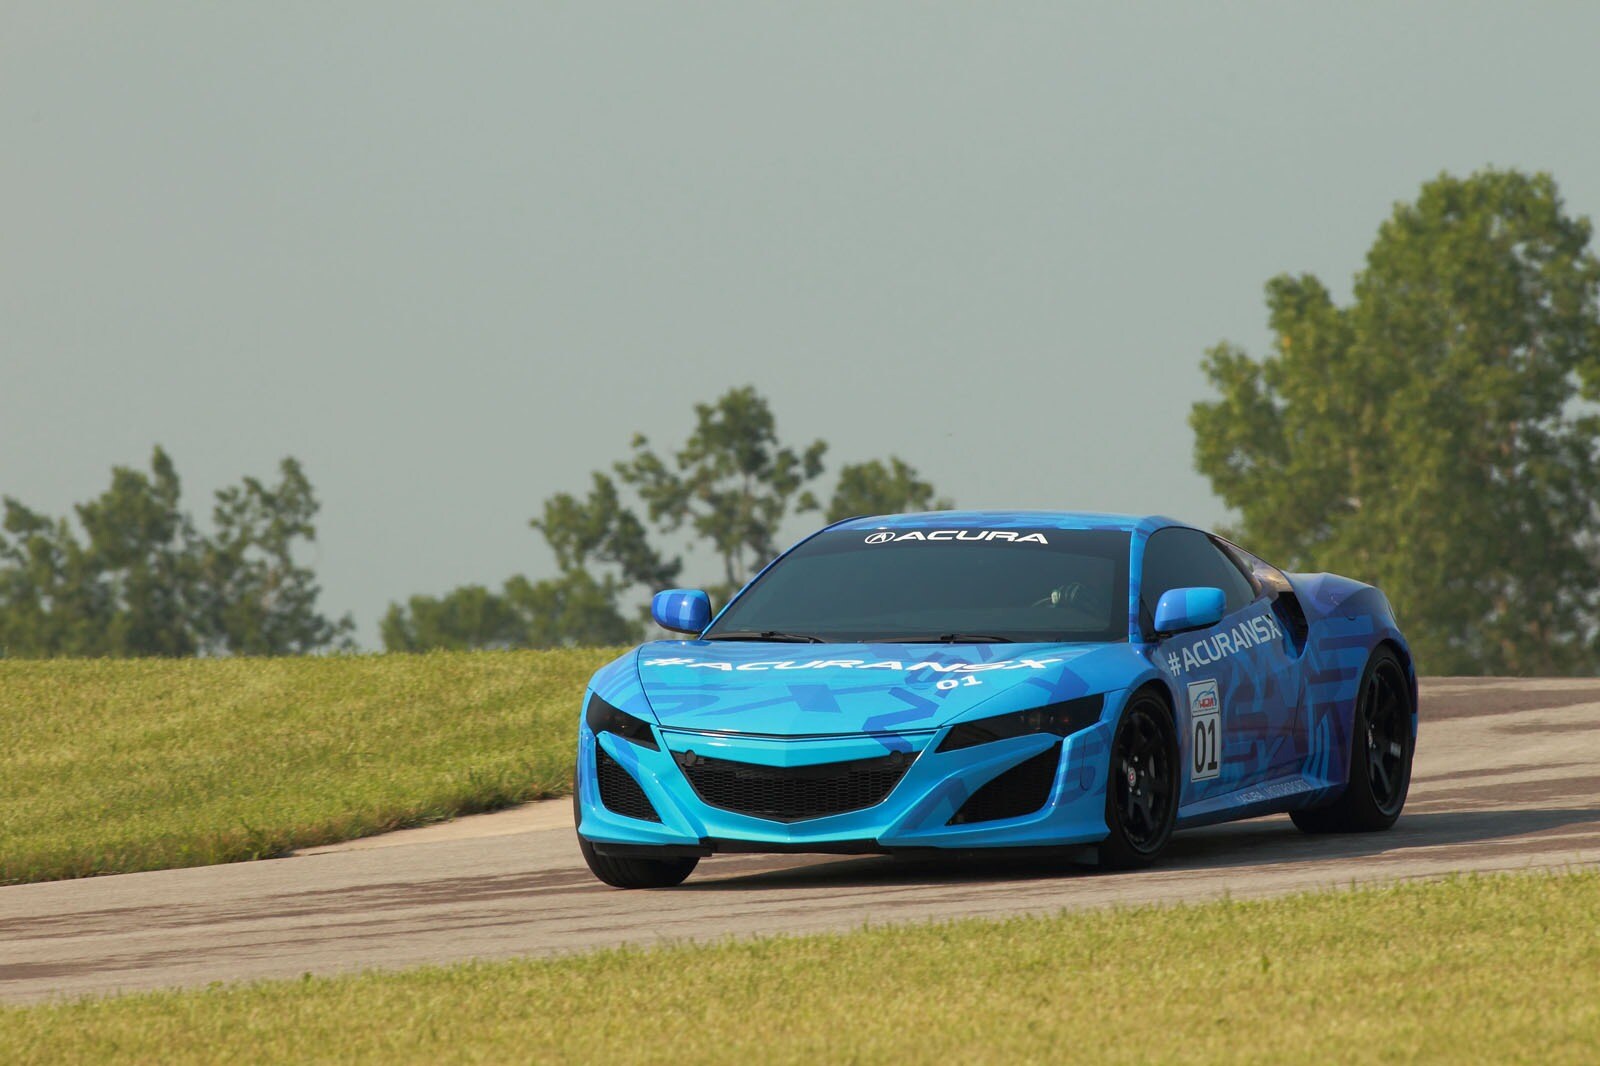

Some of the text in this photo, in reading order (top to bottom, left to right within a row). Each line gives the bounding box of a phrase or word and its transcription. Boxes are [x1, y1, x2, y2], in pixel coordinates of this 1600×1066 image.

[893, 530, 1049, 545] ACURA
[1168, 613, 1283, 677] #ACURANSX
[643, 657, 1063, 672] #ACURANSX
[936, 674, 983, 690] 01
[1194, 718, 1218, 774] 01
